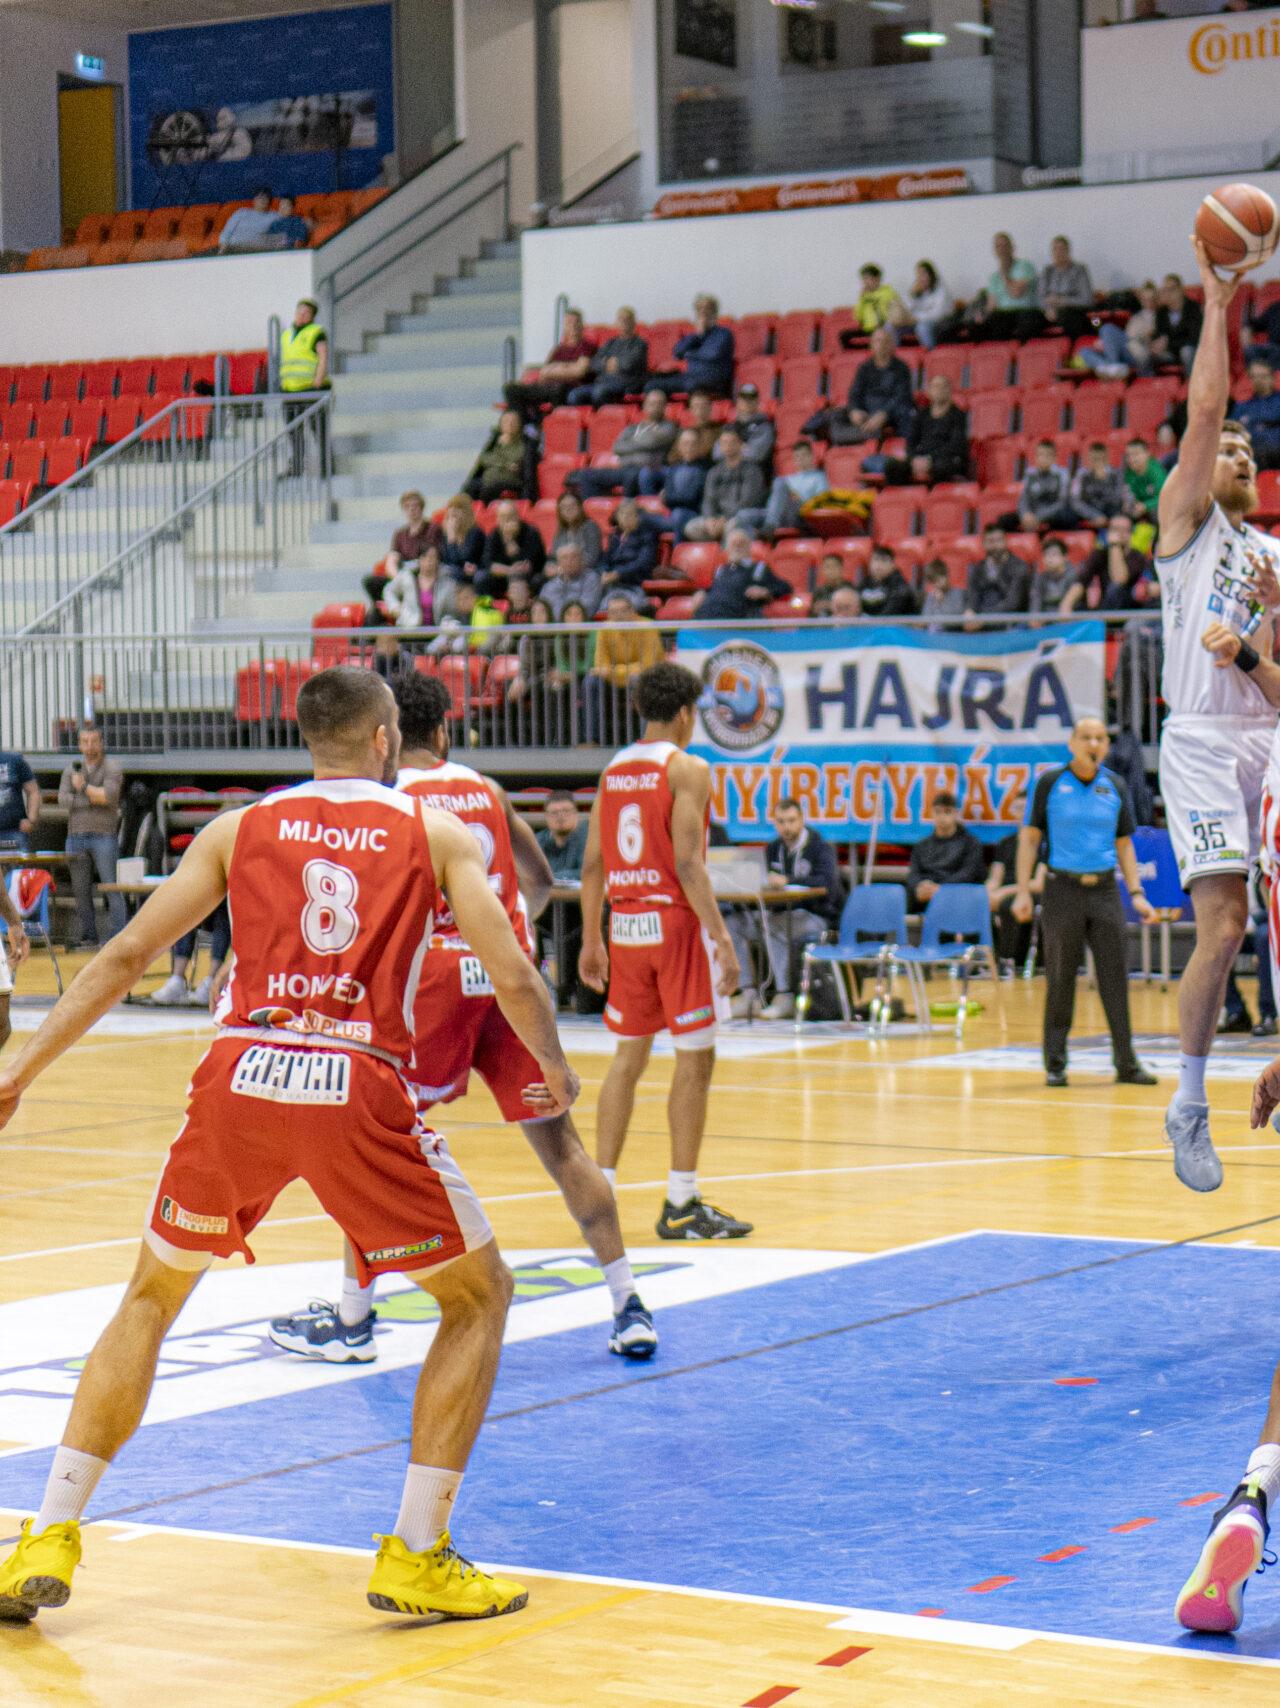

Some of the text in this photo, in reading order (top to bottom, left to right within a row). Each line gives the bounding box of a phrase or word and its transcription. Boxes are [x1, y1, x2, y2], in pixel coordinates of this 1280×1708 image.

[806, 643, 1073, 731] HAJRÁ
[710, 746, 1062, 824] NYÍREGYHÁZ
[278, 819, 389, 851] MIJOVIC
[618, 803, 644, 864] 6
[1193, 821, 1226, 852] 35
[301, 858, 359, 956] 8
